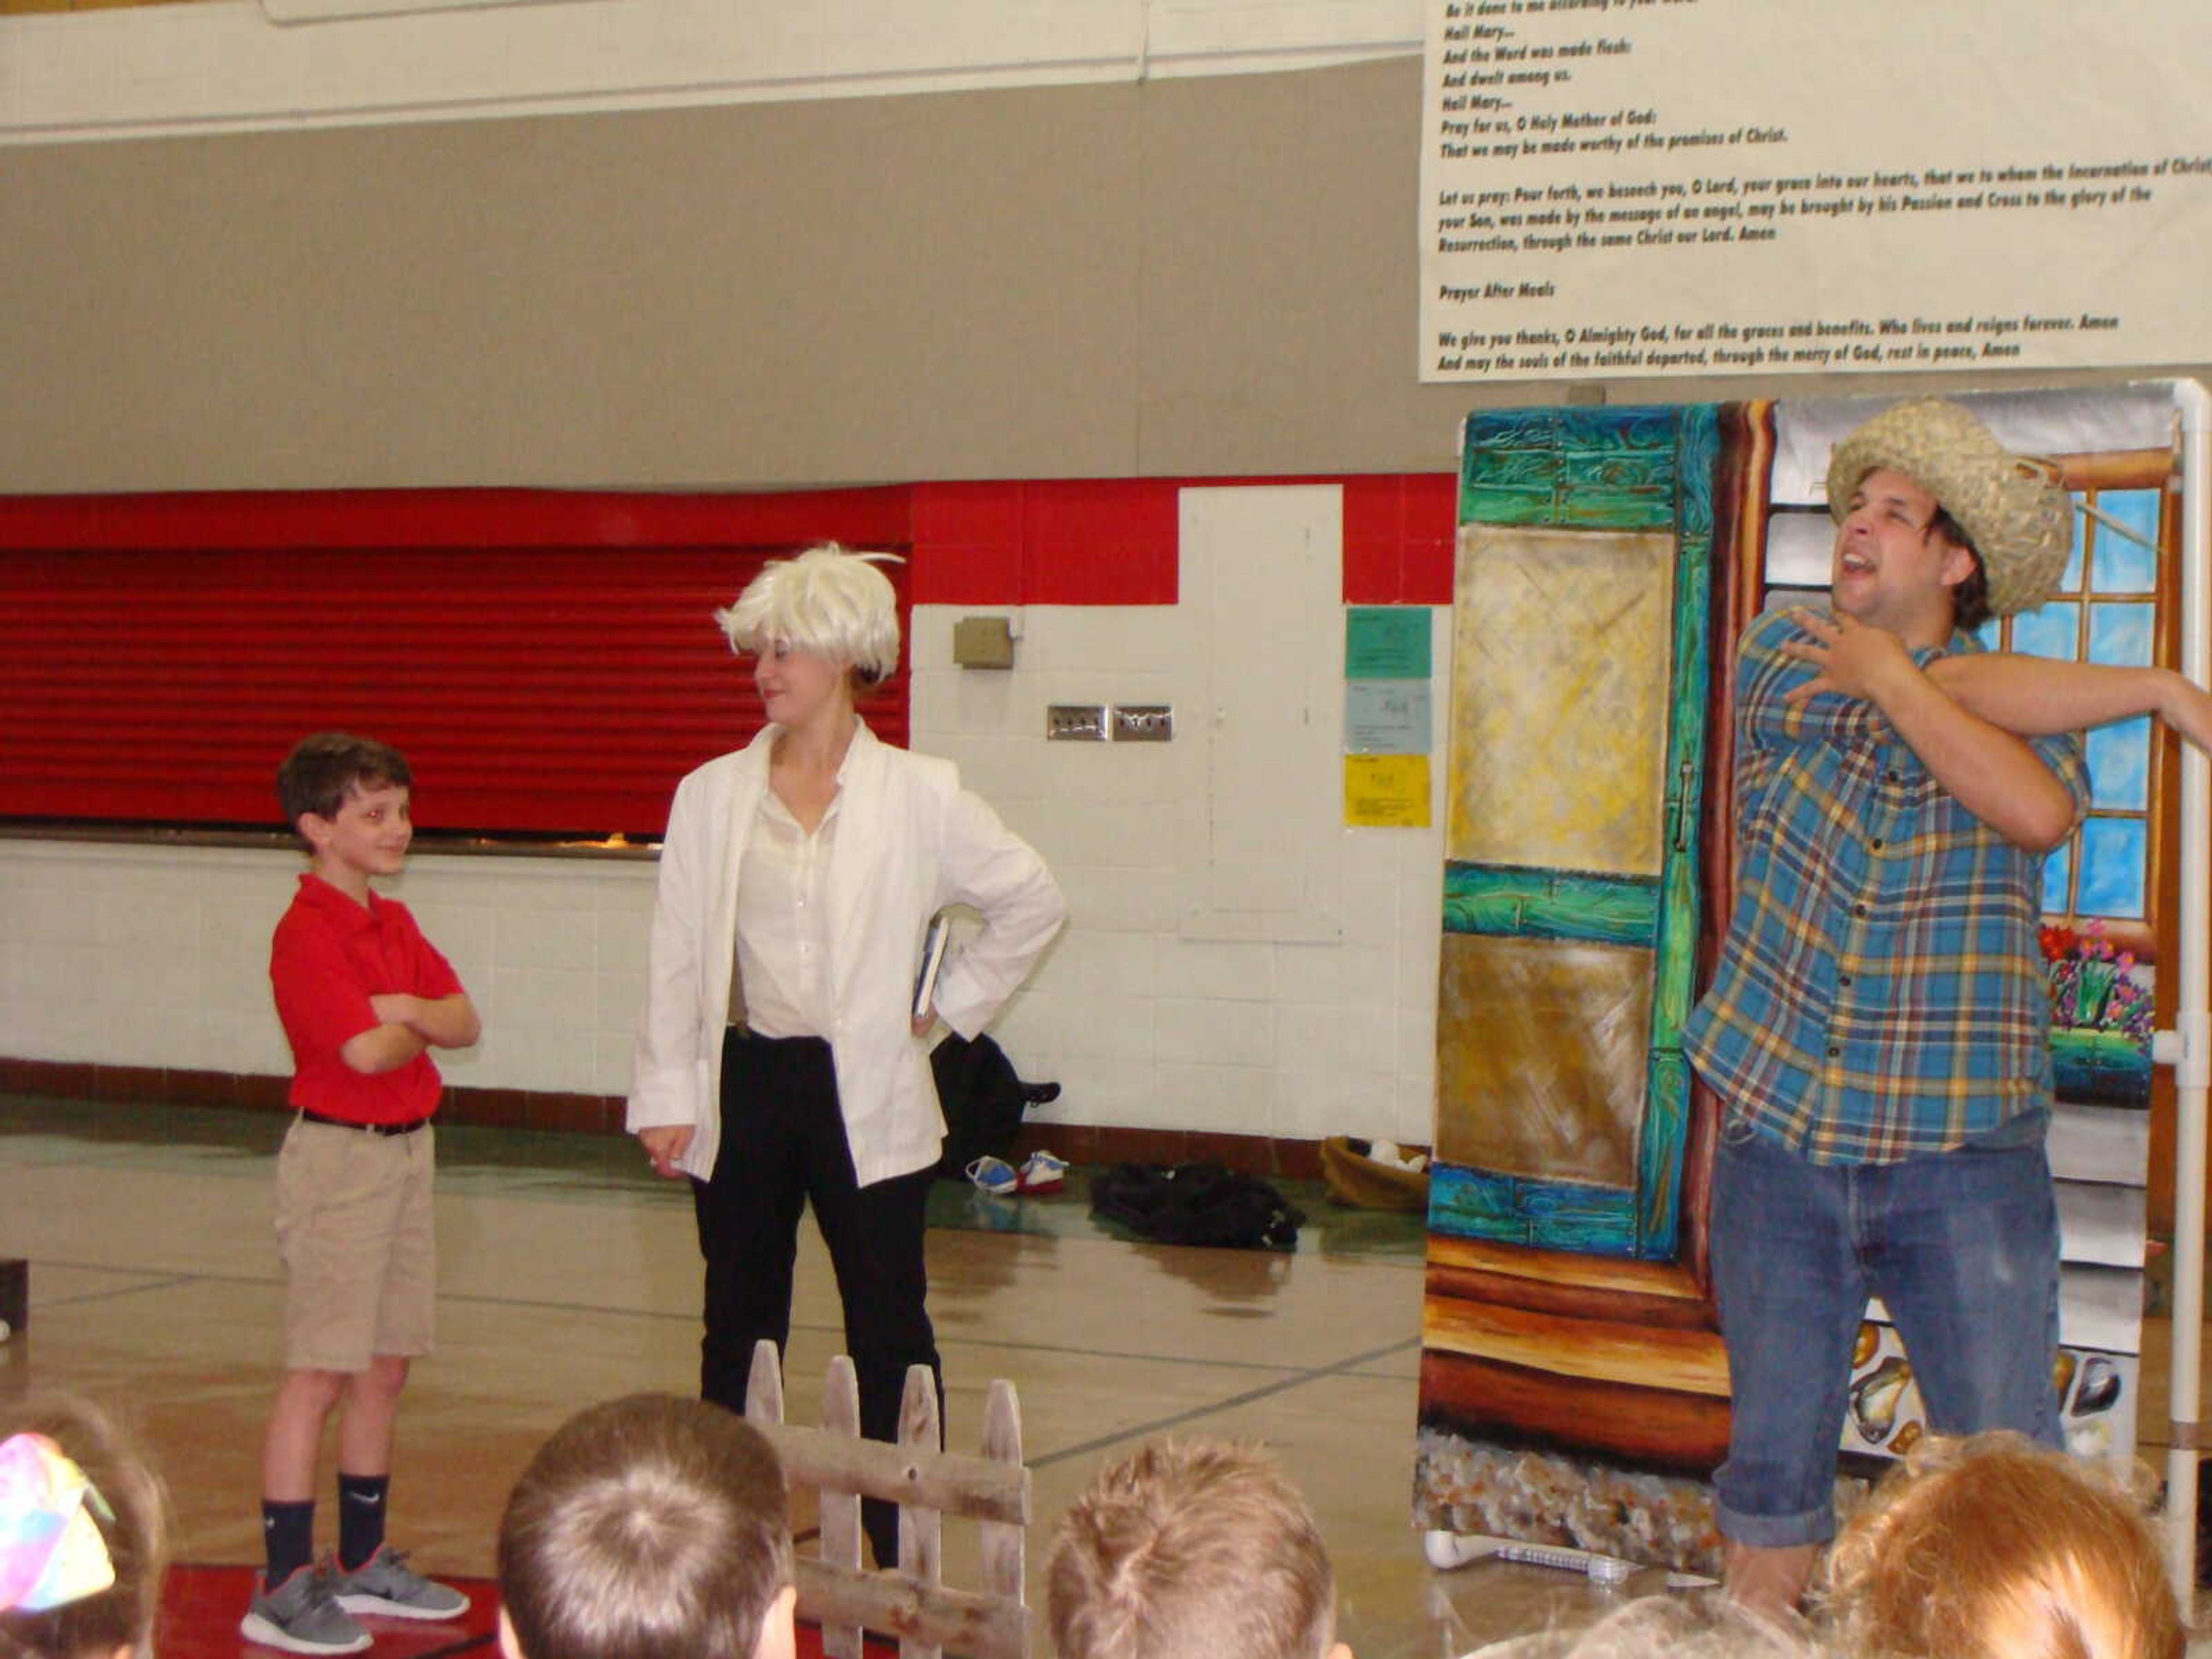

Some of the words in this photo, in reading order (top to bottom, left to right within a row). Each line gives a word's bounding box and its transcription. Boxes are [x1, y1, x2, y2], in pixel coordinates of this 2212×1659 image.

[1445, 3, 1461, 19] Be
[1464, 2, 1475, 17] it
[1477, 0, 1507, 16] done
[1511, 0, 1523, 14] to
[1526, 0, 1545, 13] me
[1444, 25, 1469, 41] Hail
[1442, 49, 1468, 65] And
[1471, 47, 1490, 62] the
[1495, 45, 1528, 61] Word
[1531, 47, 1554, 59] was
[1557, 41, 1593, 58] made
[1441, 71, 1467, 89] And
[1470, 70, 1504, 86] dwelt
[1508, 71, 1551, 87] among
[1442, 95, 1467, 112] Hail
[1440, 120, 1469, 139] Pray
[1474, 118, 1491, 133] for
[1516, 116, 1527, 131] O
[1530, 114, 1558, 134] Holy
[1561, 112, 1607, 128] Mother
[1609, 110, 1624, 126] of
[1440, 142, 1468, 159] That
[1471, 146, 1488, 157] we
[1492, 144, 1519, 160] may
[1522, 139, 1537, 155] be
[1540, 137, 1576, 154] made
[1579, 135, 1623, 155] worthy
[1626, 134, 1641, 150] of
[1643, 133, 1665, 149] the
[1668, 130, 1725, 152] promises
[1728, 128, 1743, 144] of
[1745, 127, 1787, 144] Christ.
[1438, 190, 1459, 206] Let
[1461, 194, 1475, 205] us
[1514, 187, 1544, 202] Pour
[1547, 184, 1582, 202] forth,
[1586, 188, 1604, 199] we
[1607, 181, 1658, 199] beseech
[1691, 179, 1703, 195] O
[1706, 177, 1738, 196] Lord,
[1743, 179, 1772, 196] your
[1775, 178, 1812, 195] grace
[1816, 174, 1843, 189] into
[1847, 177, 1869, 188] our
[1924, 169, 1953, 185] that
[1956, 172, 1975, 184] we
[1979, 169, 1994, 183] to
[1997, 166, 2037, 182] whom
[2041, 164, 2064, 180] the
[2153, 160, 2169, 176] of
[1438, 218, 1465, 233] your
[1500, 214, 1522, 226] was
[1526, 209, 1561, 225] made
[1566, 209, 1580, 228] by
[1585, 207, 1605, 222] the
[1609, 210, 1661, 225] message
[1666, 203, 1680, 219] of
[1683, 208, 1699, 219] an
[1748, 204, 1775, 220] may
[1779, 199, 1796, 215] be
[1800, 197, 1854, 218] brought
[1857, 196, 1874, 217] by
[1878, 195, 1897, 213] his
[1900, 194, 1953, 211] Passion
[1956, 192, 1983, 210] and
[1987, 192, 2022, 209] Cross
[2026, 192, 2040, 207] to
[2044, 189, 2066, 206] the
[2070, 188, 2107, 210] glory
[2110, 187, 2126, 204] of
[2130, 186, 2152, 202] the
[1438, 235, 1518, 253] Resurrection,
[1523, 233, 1573, 253] through
[1576, 232, 1597, 248] the
[1600, 234, 1633, 247] same
[1637, 229, 1673, 245] Christ
[1676, 232, 1698, 243] our
[1738, 226, 1776, 241] Amen
[1438, 285, 1480, 304] Prayer
[1483, 283, 1515, 299] After
[1517, 282, 1556, 298] Meals
[1438, 332, 1457, 347] We
[1461, 331, 1486, 350] give
[1489, 334, 1513, 350] you
[1516, 329, 1560, 347] thanks,
[1565, 329, 1577, 344] O
[1578, 327, 1637, 346] Almighty
[1640, 326, 1669, 343] God,
[1674, 326, 1693, 341] for
[1696, 325, 1715, 340] all
[1718, 324, 1738, 339] the
[1742, 326, 1785, 343] graces
[1788, 322, 1813, 338] and
[1815, 321, 1874, 336] benefits.
[1878, 320, 1908, 335] Who
[1911, 319, 1942, 334] lives
[1946, 318, 1974, 334] and
[1976, 317, 2019, 337] reigns
[2078, 315, 2119, 330] Amen
[1436, 353, 1463, 372] And
[1465, 358, 1491, 374] may
[1495, 353, 1514, 369] the
[1519, 352, 1549, 369] souls
[1552, 351, 1567, 368] of
[1570, 351, 1589, 367] the
[1594, 349, 1643, 366] faithful
[1713, 346, 1764, 366] through
[1769, 345, 1789, 362] the
[1793, 349, 1831, 365] mercy
[1834, 343, 1849, 361] of
[1853, 343, 1882, 362] God,
[1888, 345, 1913, 359] rest
[1917, 342, 1930, 358] in
[1982, 342, 2020, 357] Amen
